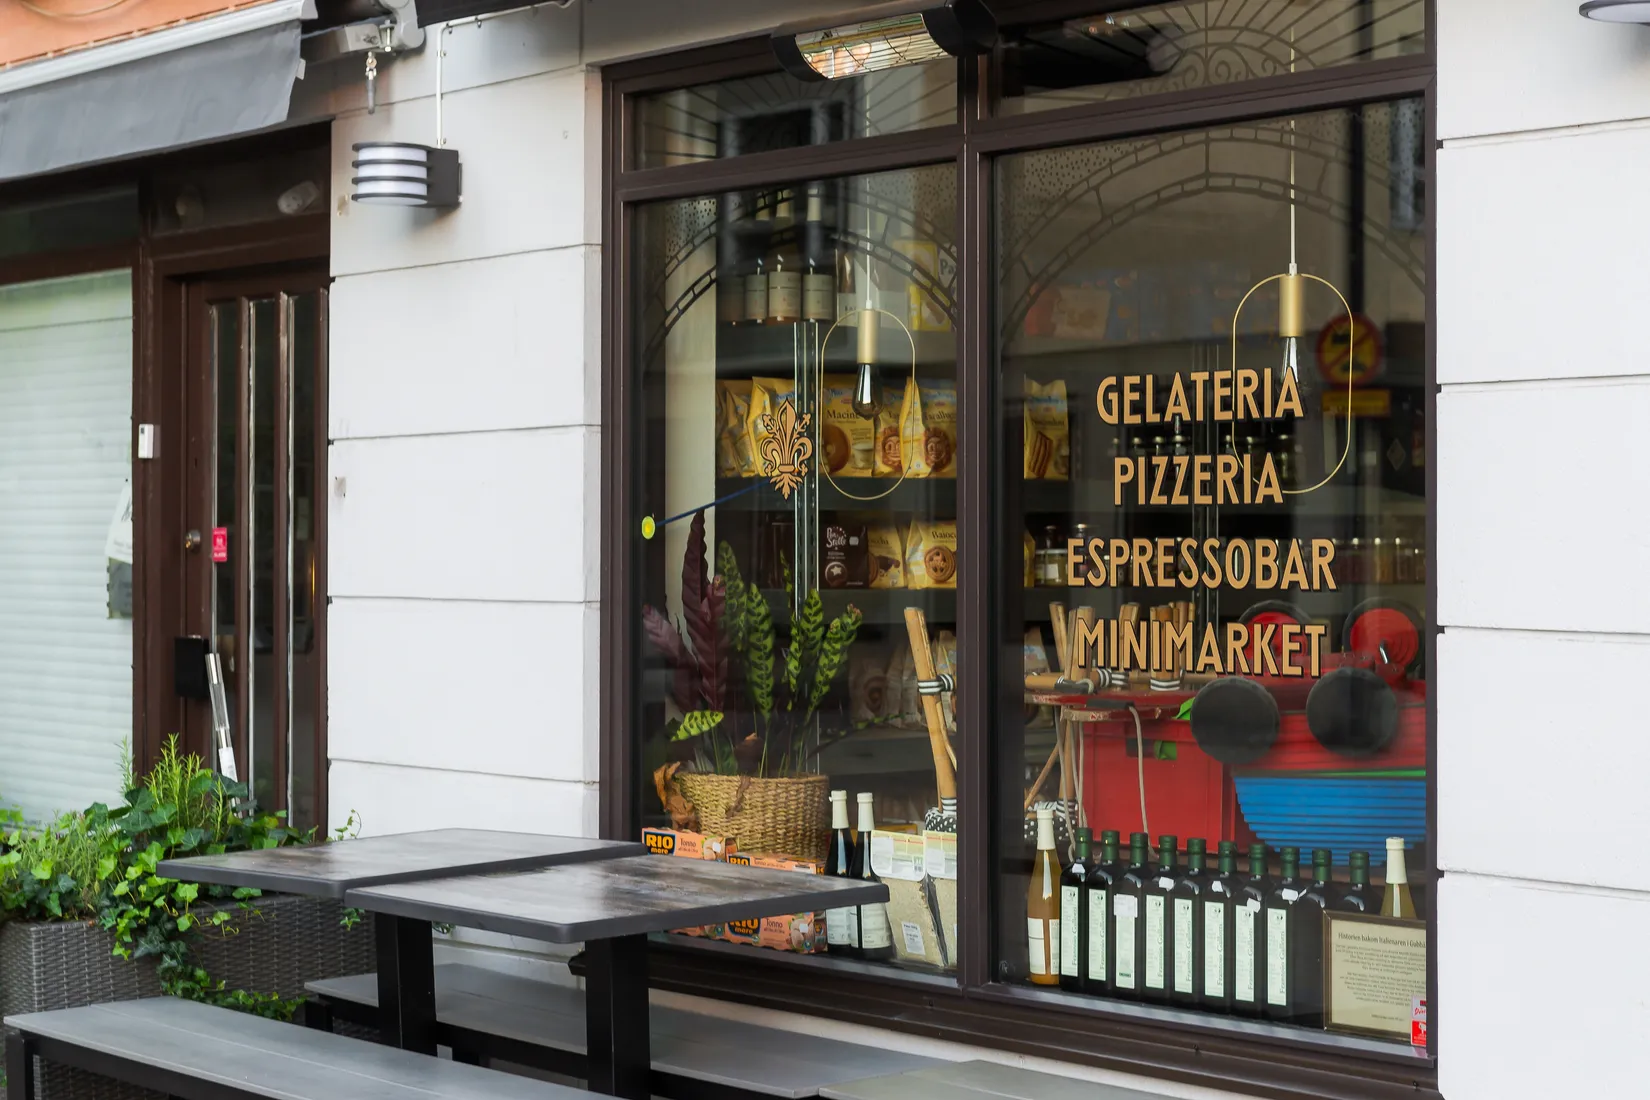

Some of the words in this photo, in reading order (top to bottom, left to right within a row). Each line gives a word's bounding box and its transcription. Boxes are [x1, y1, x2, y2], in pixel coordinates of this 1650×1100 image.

[1096, 366, 1305, 425] GELATERIA
[1113, 452, 1285, 506] PIZZERIA
[1066, 537, 1339, 592] ESPRESSOBAR
[1076, 617, 1328, 678] MINIMARKET
[645, 833, 674, 850] RIO
[650, 847, 669, 855] mare
[766, 918, 783, 929] Tonno
